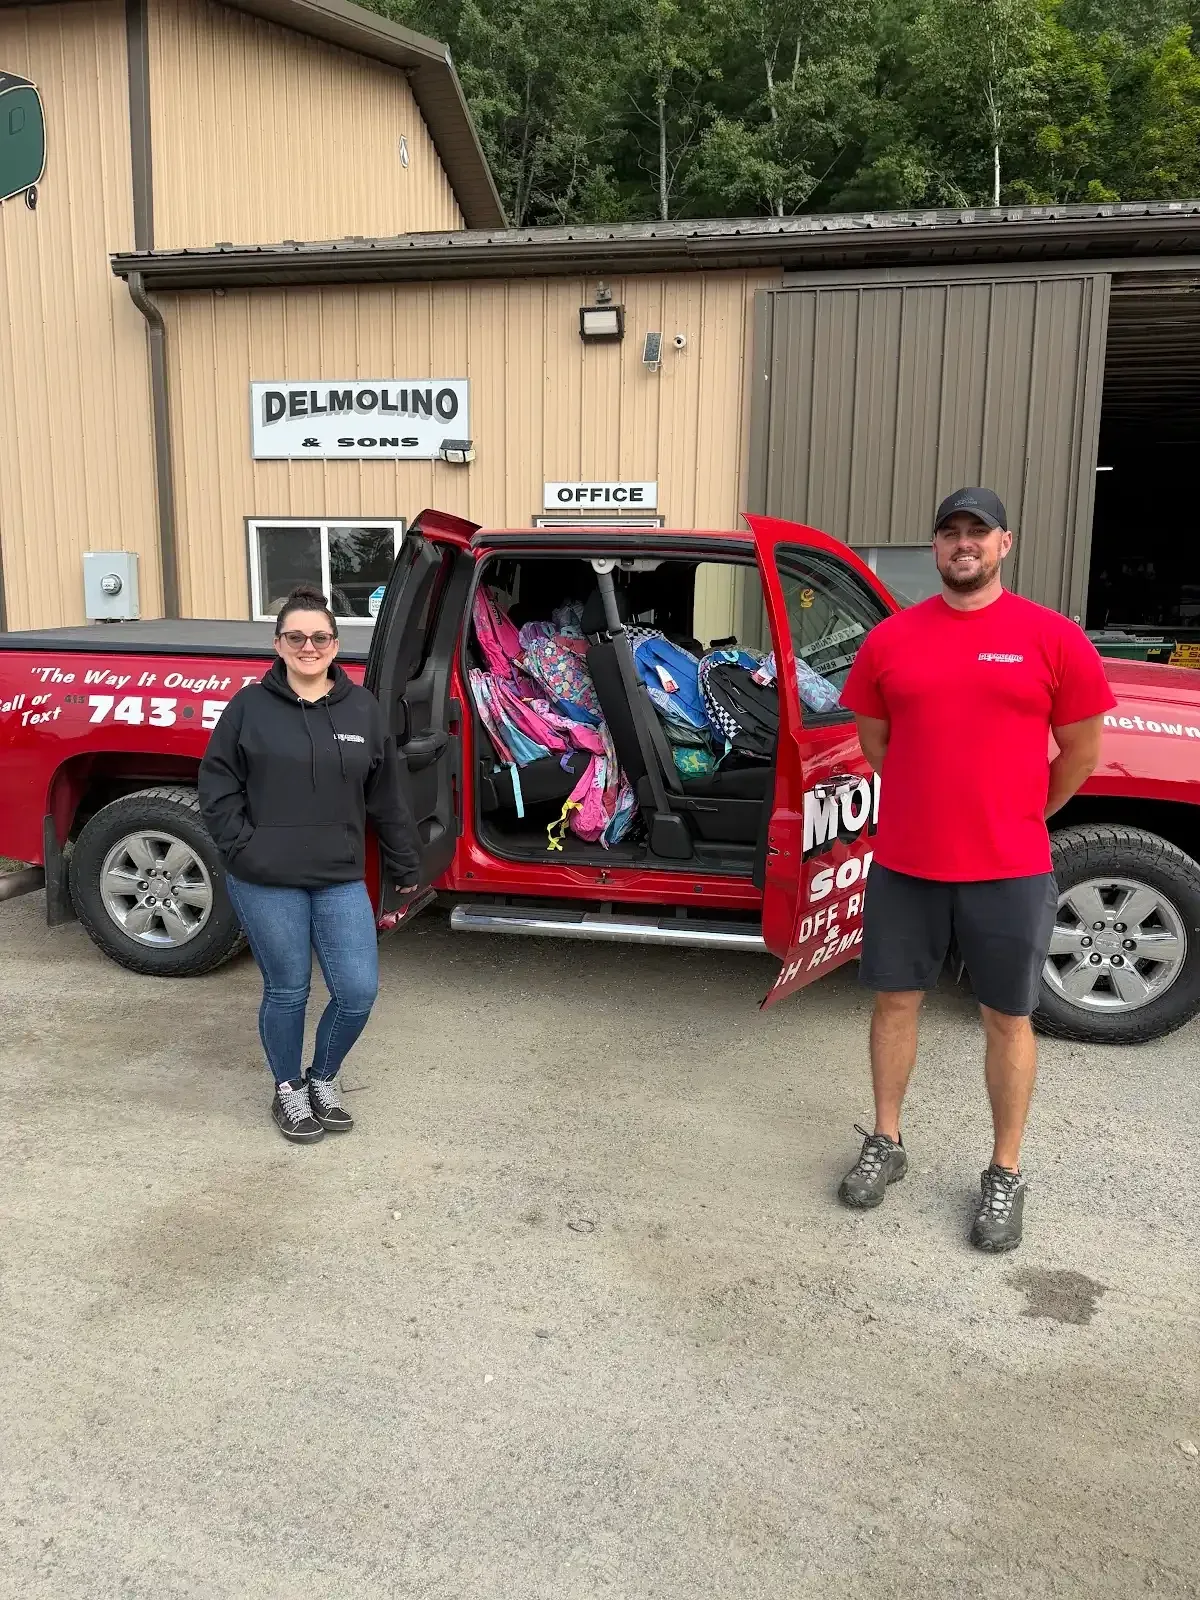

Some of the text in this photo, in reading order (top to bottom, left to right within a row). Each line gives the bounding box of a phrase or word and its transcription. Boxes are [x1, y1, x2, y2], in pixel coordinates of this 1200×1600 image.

[263, 388, 459, 426] DELMOLINO
[302, 437, 419, 447] & SONS
[557, 487, 644, 502] OFFICE
[84, 669, 131, 690] Way
[137, 671, 157, 687] It
[163, 672, 232, 693] Ought
[0, 693, 52, 713] all or
[21, 706, 62, 727] Text
[798, 902, 840, 944] OFF
[823, 924, 841, 944] &
